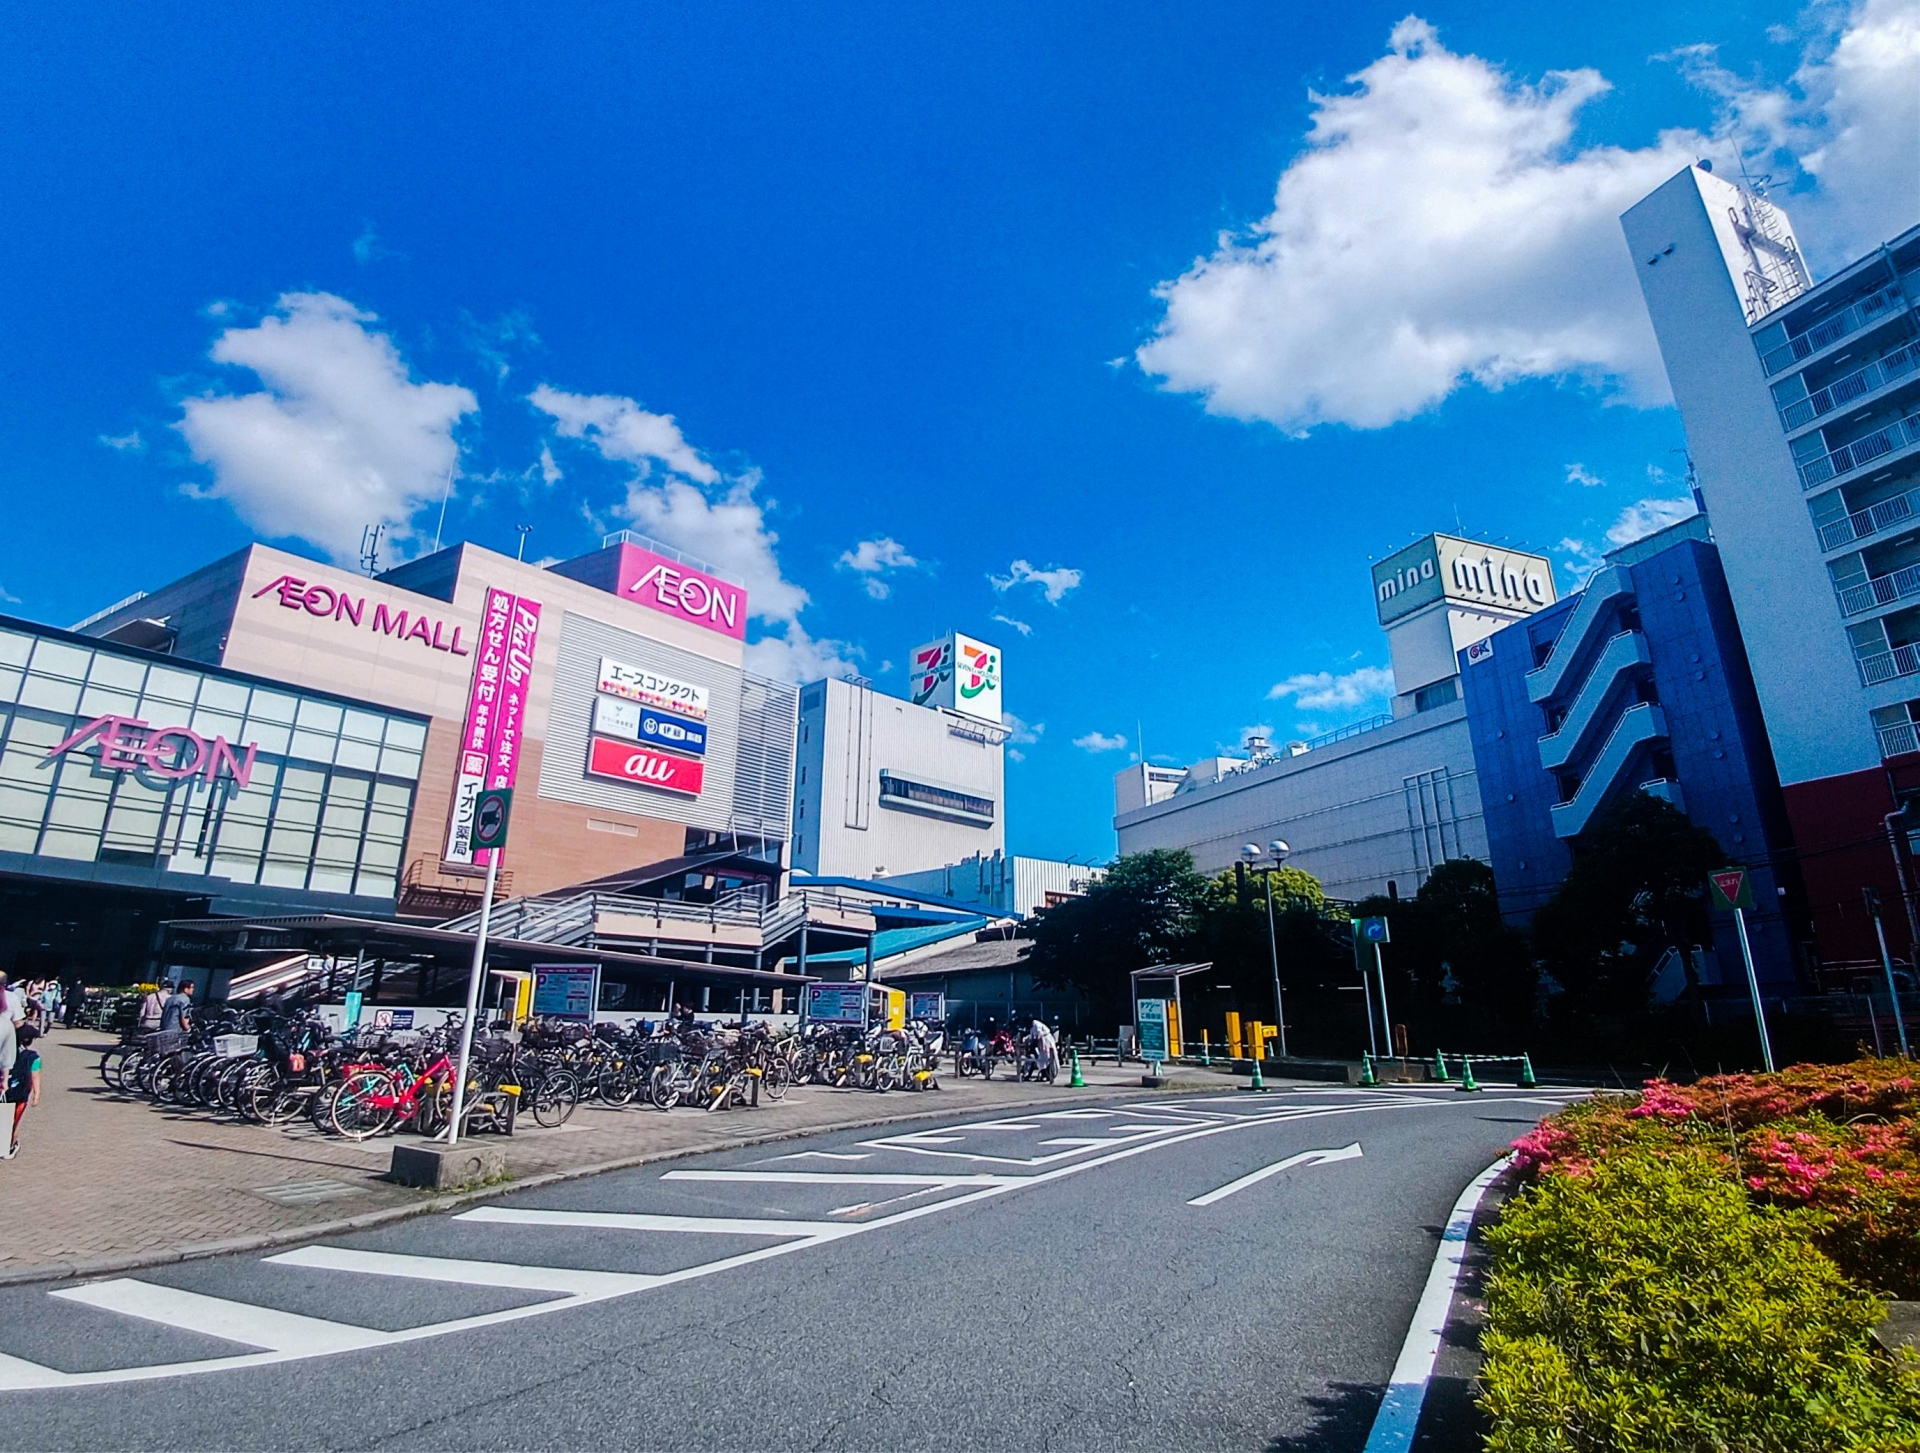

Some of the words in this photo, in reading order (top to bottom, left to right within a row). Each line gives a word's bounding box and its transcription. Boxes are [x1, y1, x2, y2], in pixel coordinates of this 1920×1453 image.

[1378, 558, 1435, 602] mina
[1454, 555, 1547, 606] mina
[373, 603, 469, 656] MALL
[477, 593, 510, 702] 処方せん受付
[610, 665, 700, 702] エースコンタクト
[624, 754, 675, 781] au
[453, 782, 478, 856] イオン薬局
